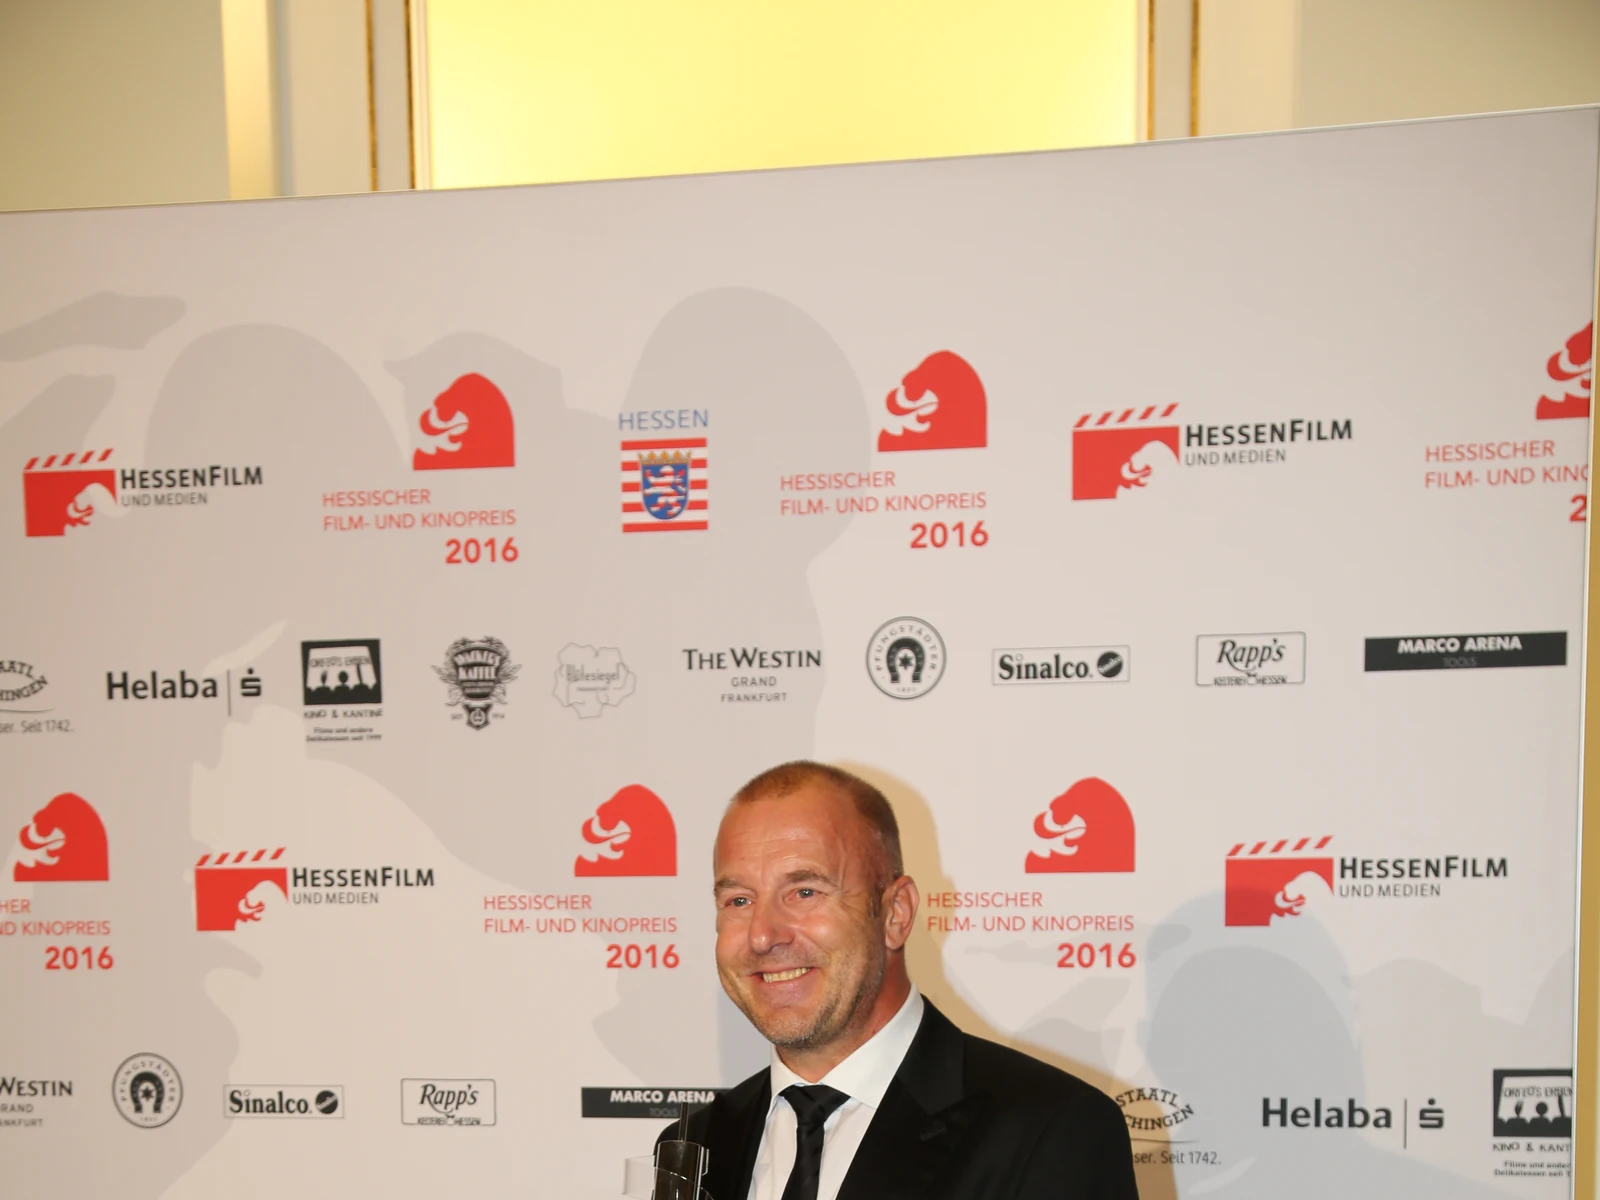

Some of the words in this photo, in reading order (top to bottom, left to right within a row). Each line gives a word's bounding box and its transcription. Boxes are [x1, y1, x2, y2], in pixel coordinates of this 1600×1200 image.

[619, 409, 708, 430] HESSEN
[1223, 449, 1285, 464] MEDIEN
[1425, 440, 1555, 462] HESSISCHER
[780, 471, 895, 491] HESSISCHER
[1425, 470, 1479, 488] FILM-
[1487, 467, 1535, 486] UND
[154, 492, 207, 506] MEDIEN
[323, 489, 430, 508] HESSISCHER
[781, 498, 829, 515] FILM-
[836, 497, 879, 514] UND
[885, 492, 986, 511] KINOPREIS
[324, 515, 369, 531] FILM-
[375, 513, 416, 530] UND
[421, 509, 516, 527] KINOPREIS
[910, 521, 989, 549] 2016
[446, 537, 519, 564] 2016
[1216, 638, 1286, 669] Rapp's
[1398, 638, 1460, 653] MARCO
[1464, 635, 1523, 651] ARENA
[683, 649, 727, 670] THE
[730, 648, 821, 668] WESTIN
[107, 670, 217, 699] Helaba
[731, 676, 776, 687] GRAND
[721, 692, 787, 702] FRANKFURT
[326, 892, 378, 904] MEDIEN
[928, 892, 1042, 908] HESSISCHER
[1378, 884, 1440, 897] MEDIEN
[484, 895, 592, 910] HESSISCHER
[22, 920, 111, 936] KINOPREIS
[484, 918, 530, 933] FILM-
[536, 918, 576, 933] UND
[582, 917, 677, 933] KINOPREIS
[928, 916, 976, 932] FILM-
[983, 916, 1026, 931] UND
[1032, 915, 1134, 931] KINOPREIS
[45, 946, 114, 970] 2016
[606, 944, 680, 968] 2016
[1057, 943, 1136, 968] 2016
[419, 1083, 479, 1112] Rapp's
[610, 1090, 664, 1103] MARCO
[666, 1090, 715, 1103] ARENA
[0, 1104, 34, 1112] RAND
[1125, 1104, 1195, 1130] CHINGEN
[1263, 1098, 1391, 1128] Helaba
[1134, 1153, 1157, 1164] ser.
[1160, 1151, 1185, 1164] Seit
[1188, 1151, 1222, 1165] 1742.
[1540, 1144, 1571, 1153] KANT
